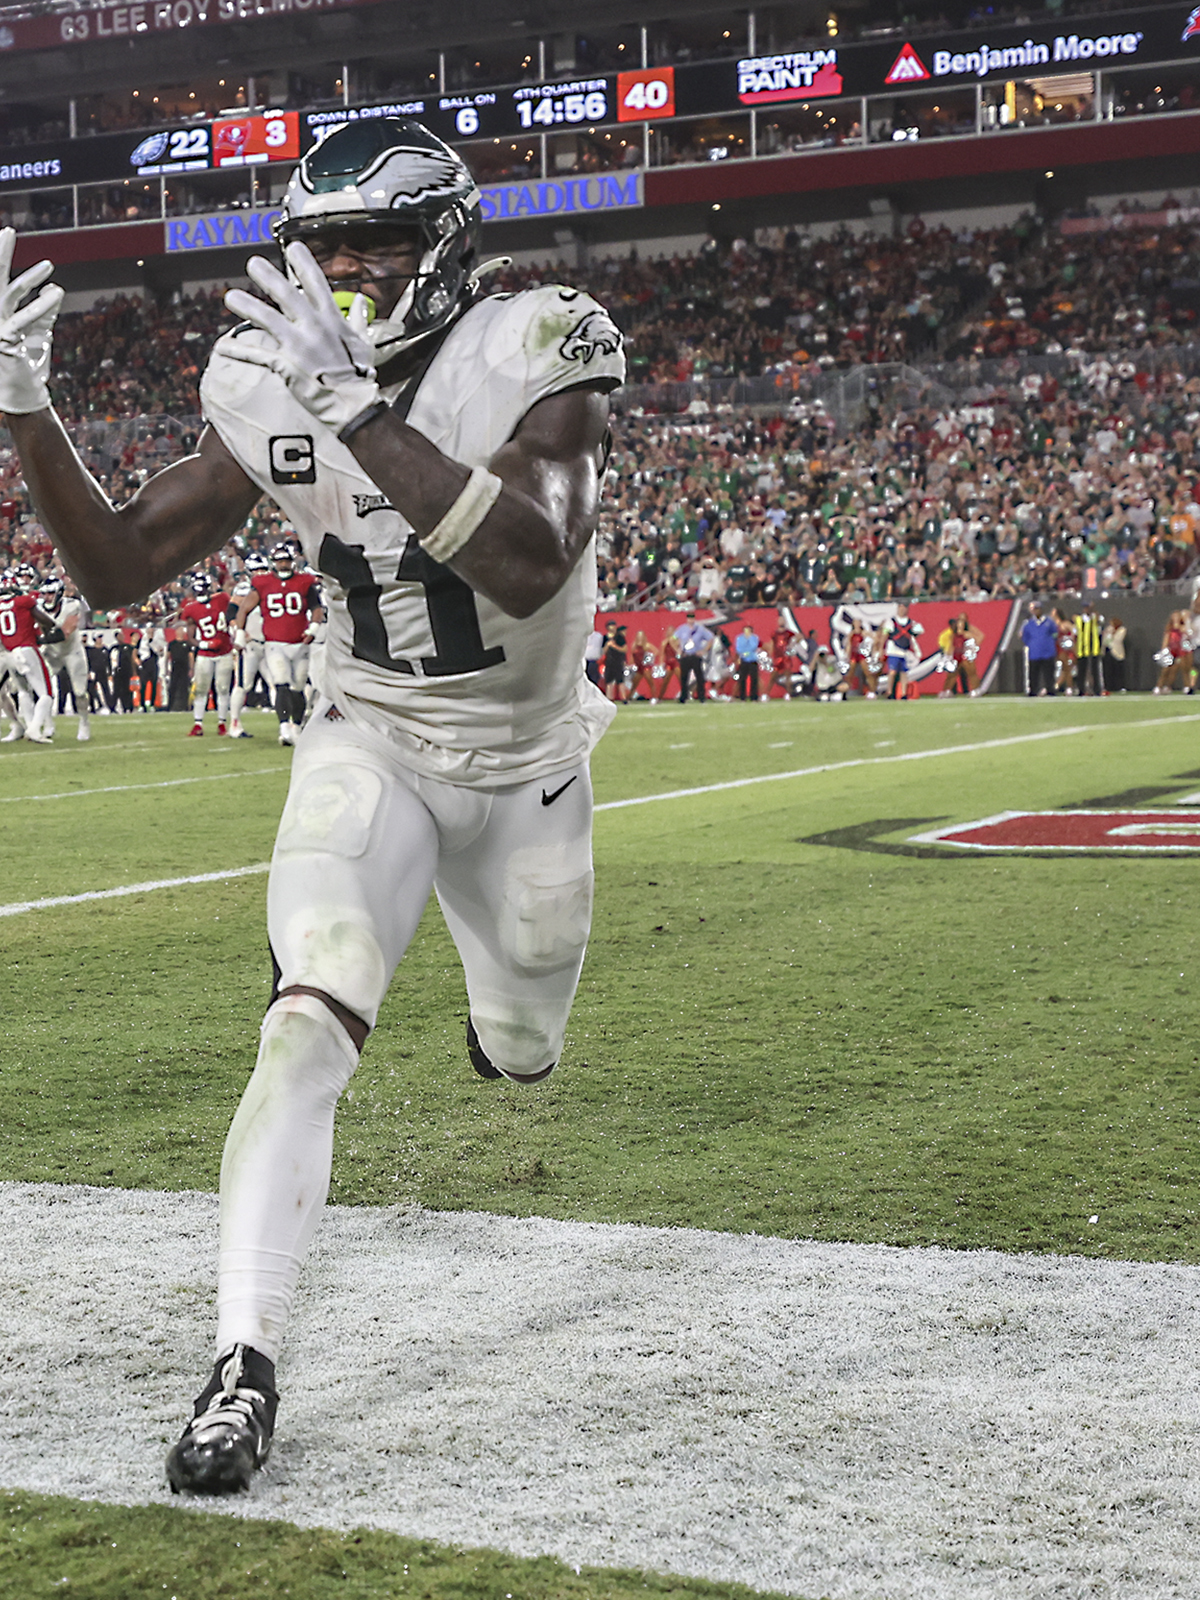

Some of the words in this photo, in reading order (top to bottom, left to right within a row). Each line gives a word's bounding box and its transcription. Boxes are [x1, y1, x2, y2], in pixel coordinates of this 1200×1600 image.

[60, 16, 88, 40] 63
[97, 6, 146, 36] LEE
[737, 50, 837, 74] SPECTRUM
[933, 41, 1049, 76] Benjamin
[1054, 33, 1137, 60] Moore
[513, 88, 543, 100] 4TH
[546, 79, 608, 96] QUARTER
[739, 66, 818, 93] PAINT
[439, 97, 473, 111] BALL
[476, 93, 496, 106] ON
[624, 80, 668, 109] 40
[307, 113, 347, 125] DOWN
[360, 101, 425, 119] DISTANCE
[456, 107, 479, 135] 6
[516, 92, 607, 129] 14:56
[169, 129, 210, 159] 22
[265, 120, 287, 147] 3
[479, 174, 639, 219] STADIUM
[271, 436, 314, 473] C
[267, 592, 302, 618] 50
[318, 531, 506, 677] 11
[0, 610, 17, 636] 0
[199, 611, 228, 638] 54
